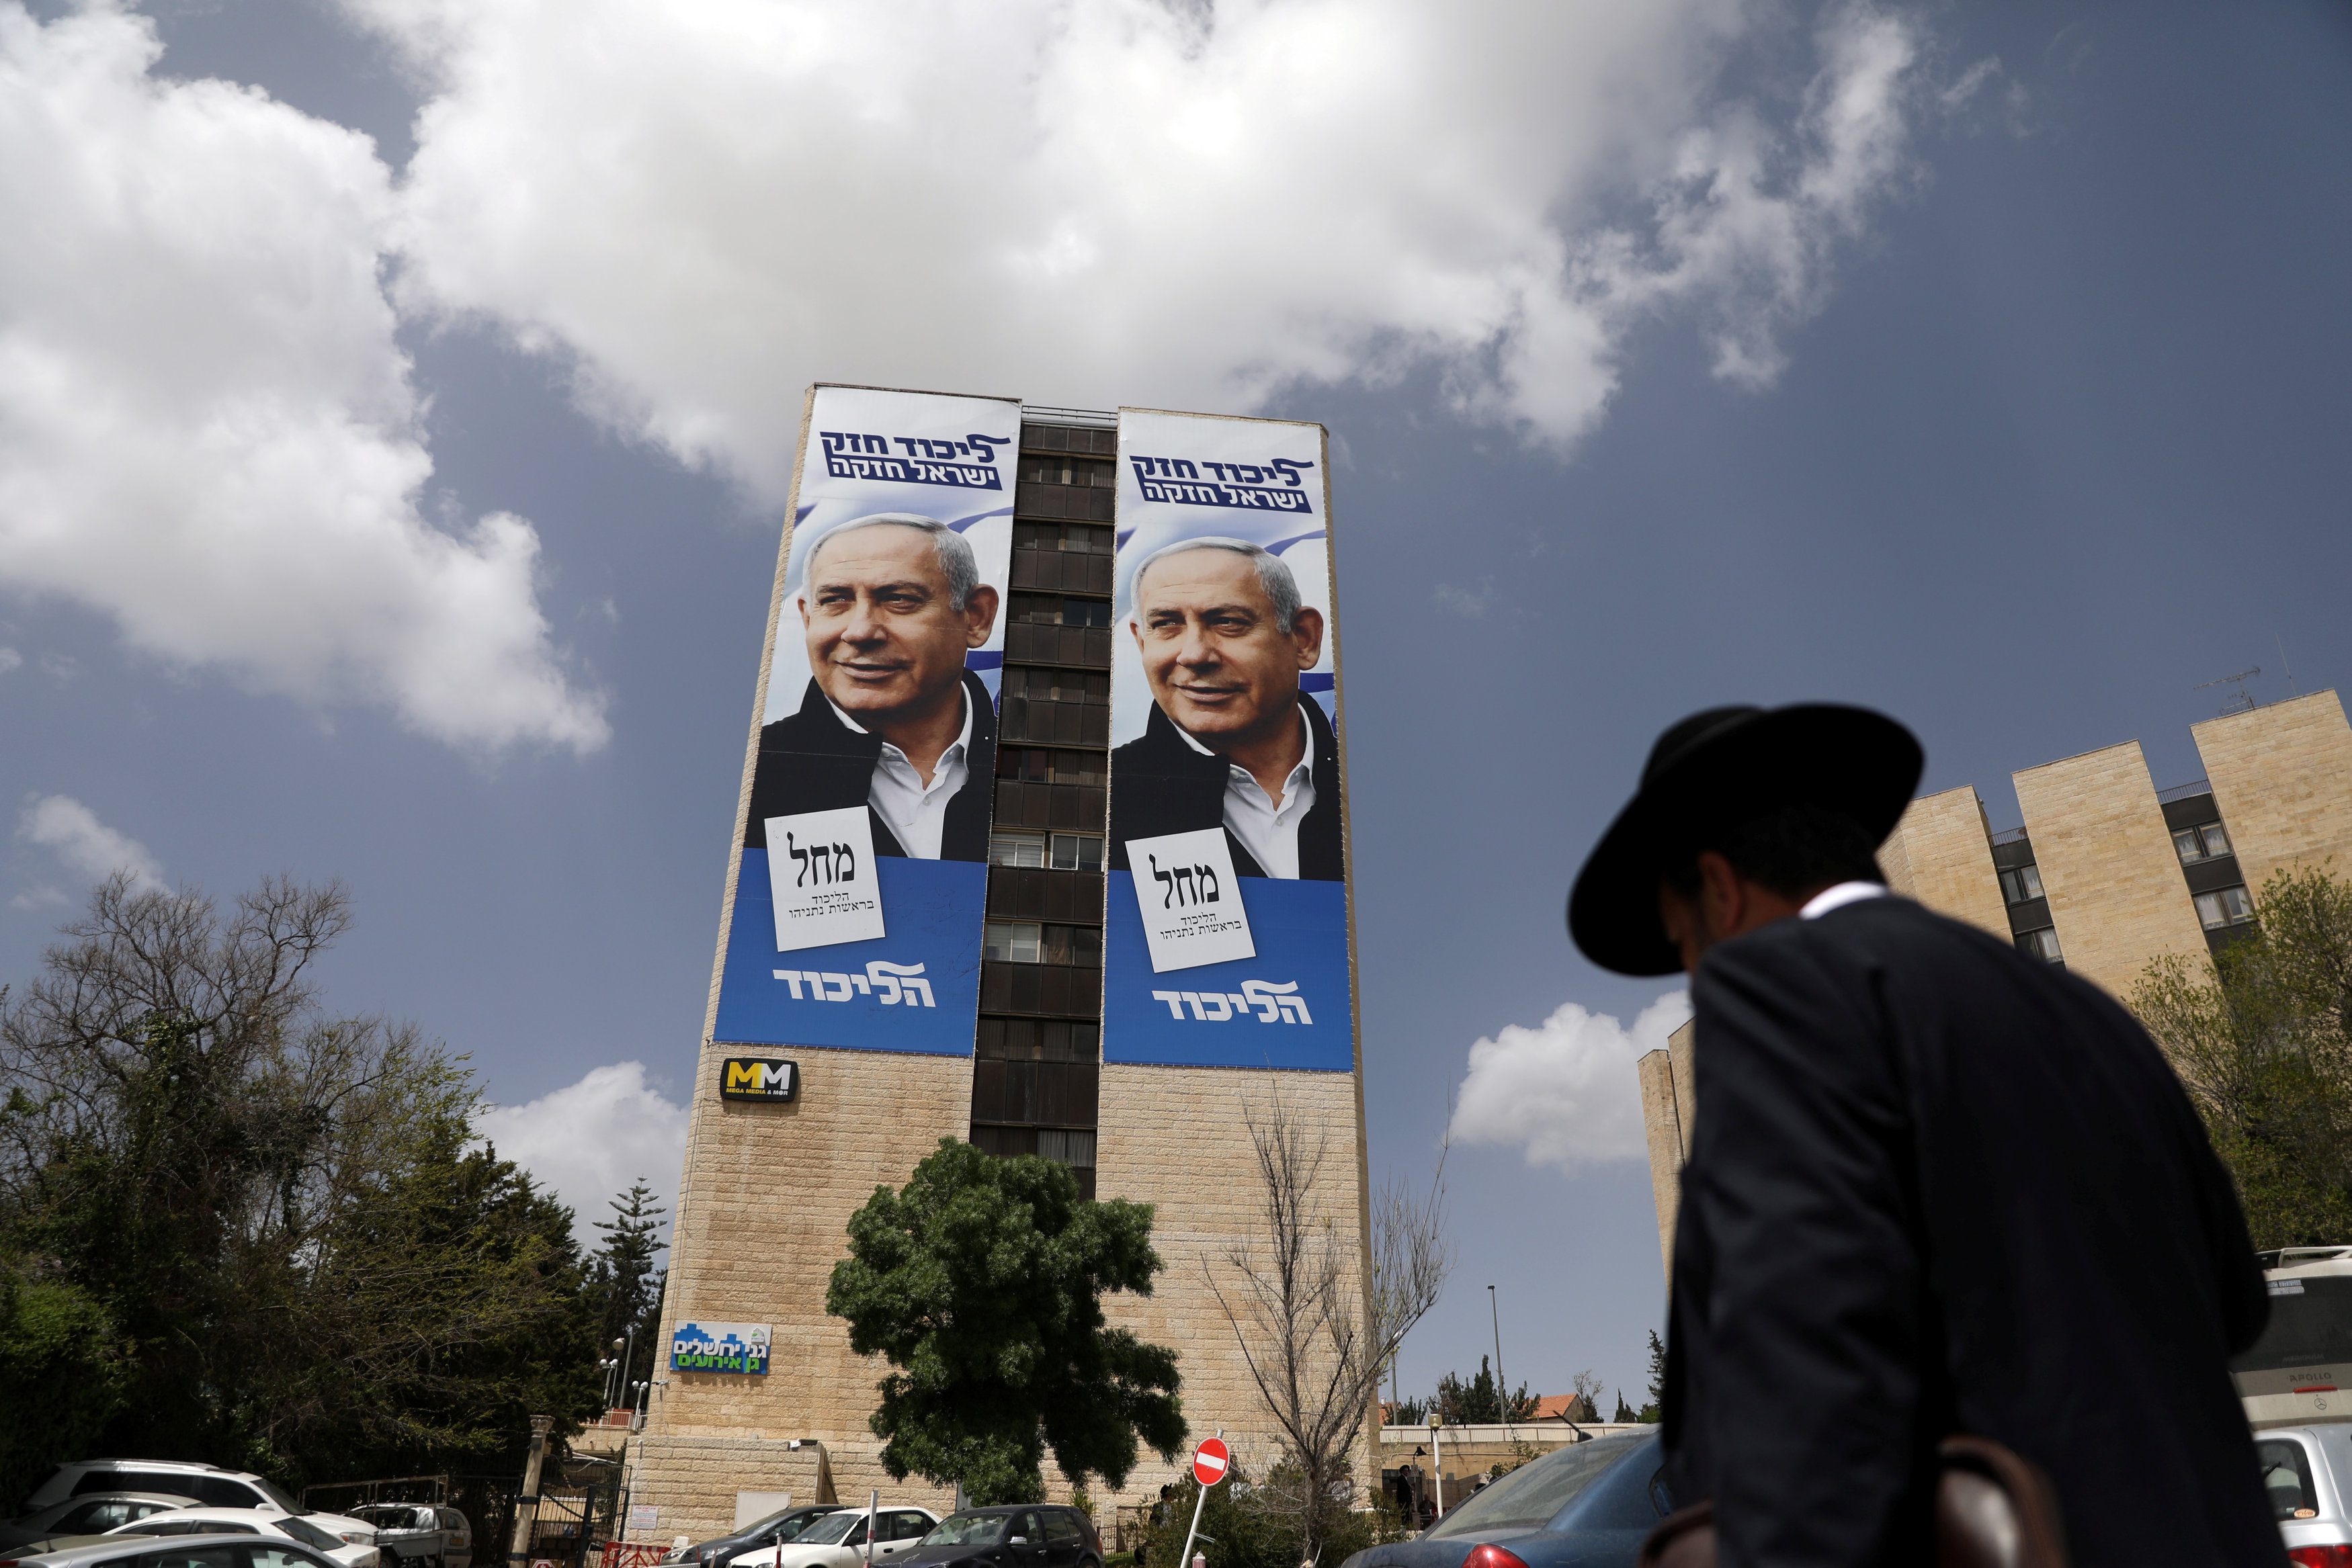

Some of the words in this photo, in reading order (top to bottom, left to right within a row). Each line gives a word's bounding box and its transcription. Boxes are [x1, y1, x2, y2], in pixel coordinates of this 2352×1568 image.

[819, 431, 889, 456] חזק
[893, 433, 1011, 464] ליכוד
[831, 458, 906, 479] חזקה
[908, 460, 995, 486] ישראל
[1129, 455, 1200, 481] חזק
[1201, 458, 1314, 487] ליכוד
[1144, 482, 1218, 504] חזקה
[1221, 484, 1304, 509] ישראל
[787, 831, 855, 887] מחל
[1148, 853, 1220, 909] מחל
[812, 891, 849, 904] הליכוד
[829, 900, 874, 914] בראשות
[788, 906, 824, 918] נתניהו
[1180, 912, 1217, 926] הליכוד
[1160, 927, 1194, 939] נתניהו
[1198, 920, 1242, 934] בראשות
[773, 961, 936, 1007] הליכוד
[1151, 979, 1313, 1025] הליכוד
[727, 1061, 791, 1090] MM
[673, 1338, 741, 1356] ירושלים
[745, 1344, 767, 1358] גני
[677, 1354, 741, 1369] אירועים
[745, 1358, 760, 1373] גן
[2289, 1372, 2332, 1383] APOLLO
